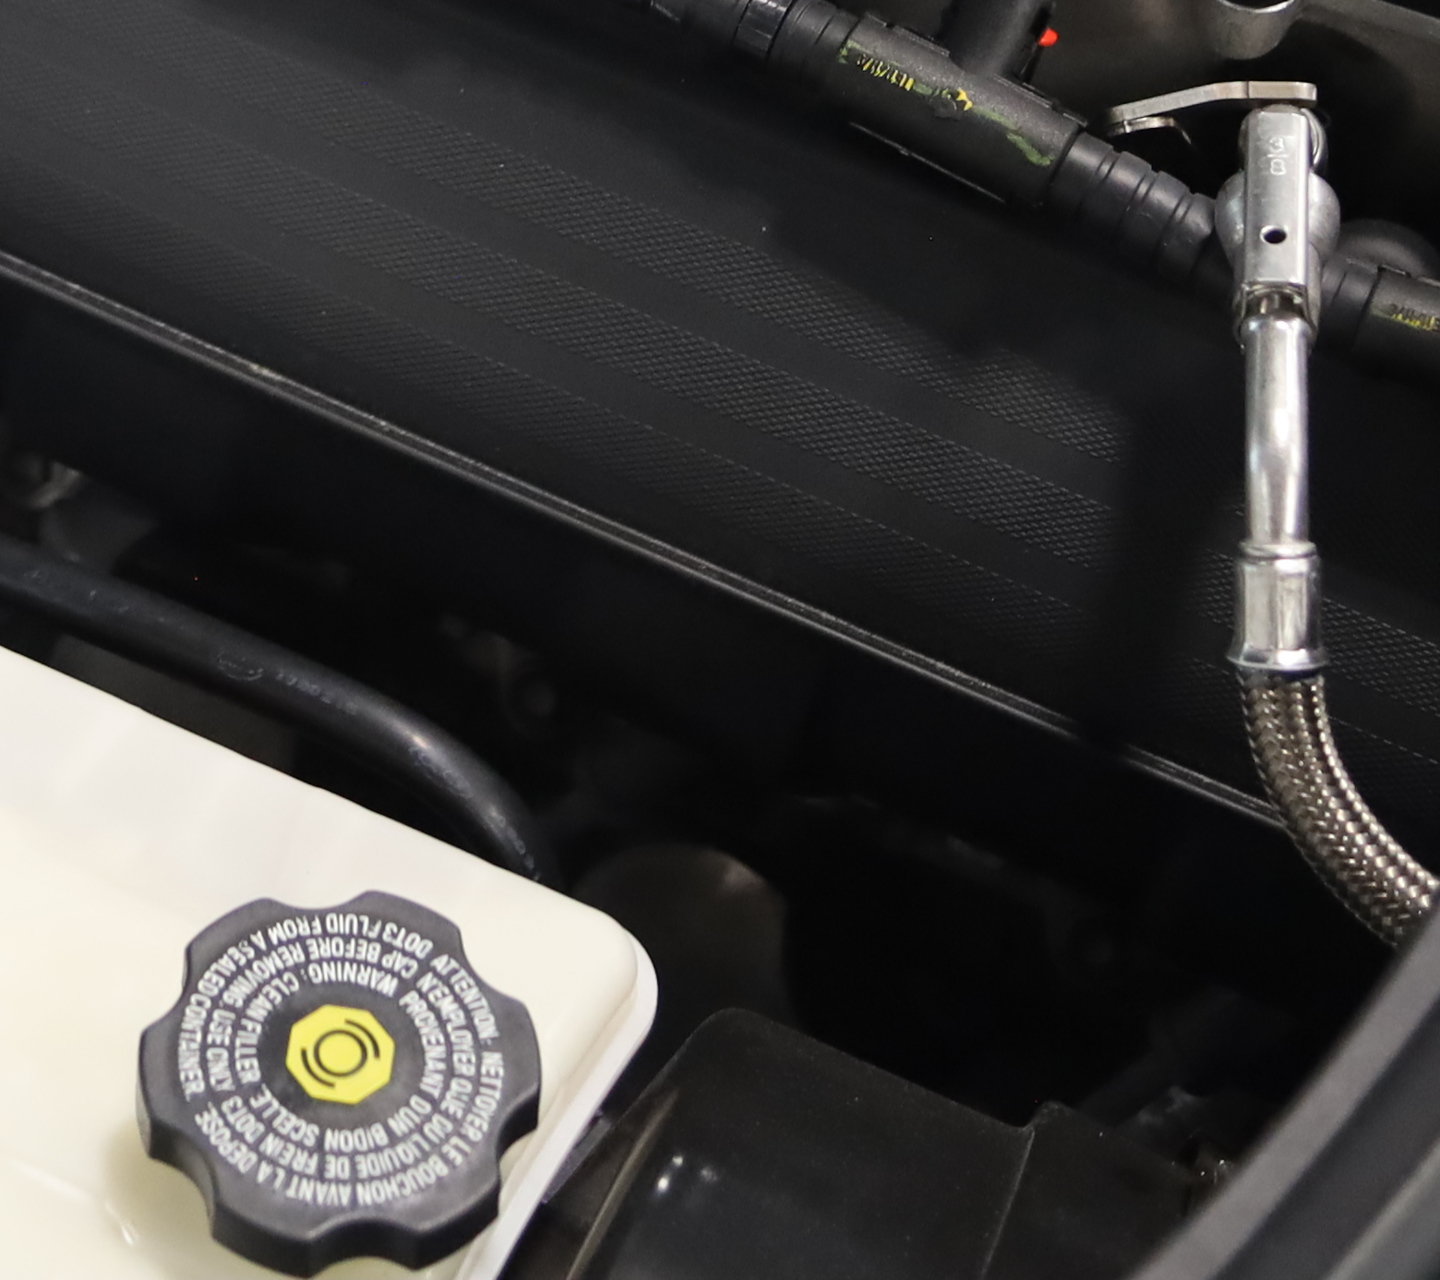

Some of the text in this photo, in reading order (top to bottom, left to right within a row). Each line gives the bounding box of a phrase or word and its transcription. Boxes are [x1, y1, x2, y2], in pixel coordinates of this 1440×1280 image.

[250, 930, 267, 950] A
[268, 915, 322, 946] FROM
[326, 912, 382, 939] FLUID
[383, 922, 434, 954] DOT3
[309, 937, 382, 963] BEFORE
[382, 951, 419, 979] CAP
[195, 941, 256, 1000] SEALED
[246, 971, 300, 1022] CLEAN
[208, 1009, 236, 1047] USE
[399, 991, 447, 1100] PROVENANT
[235, 1019, 262, 1085] FILLER
[206, 1048, 236, 1092] ONLY
[441, 1078, 473, 1120] QUE
[470, 1051, 504, 1143] NETTOYER
[220, 1095, 265, 1144] DOT3
[423, 1113, 453, 1143] DU
[260, 1132, 319, 1176] FREIN
[324, 1125, 389, 1153] BIDON
[355, 1133, 431, 1179] LIQUIDE
[443, 1135, 474, 1168] LE
[257, 1167, 286, 1192] LA
[324, 1154, 350, 1179] DE
[357, 1162, 450, 1206] BOUCHON
[285, 1177, 351, 1207] AVANT
